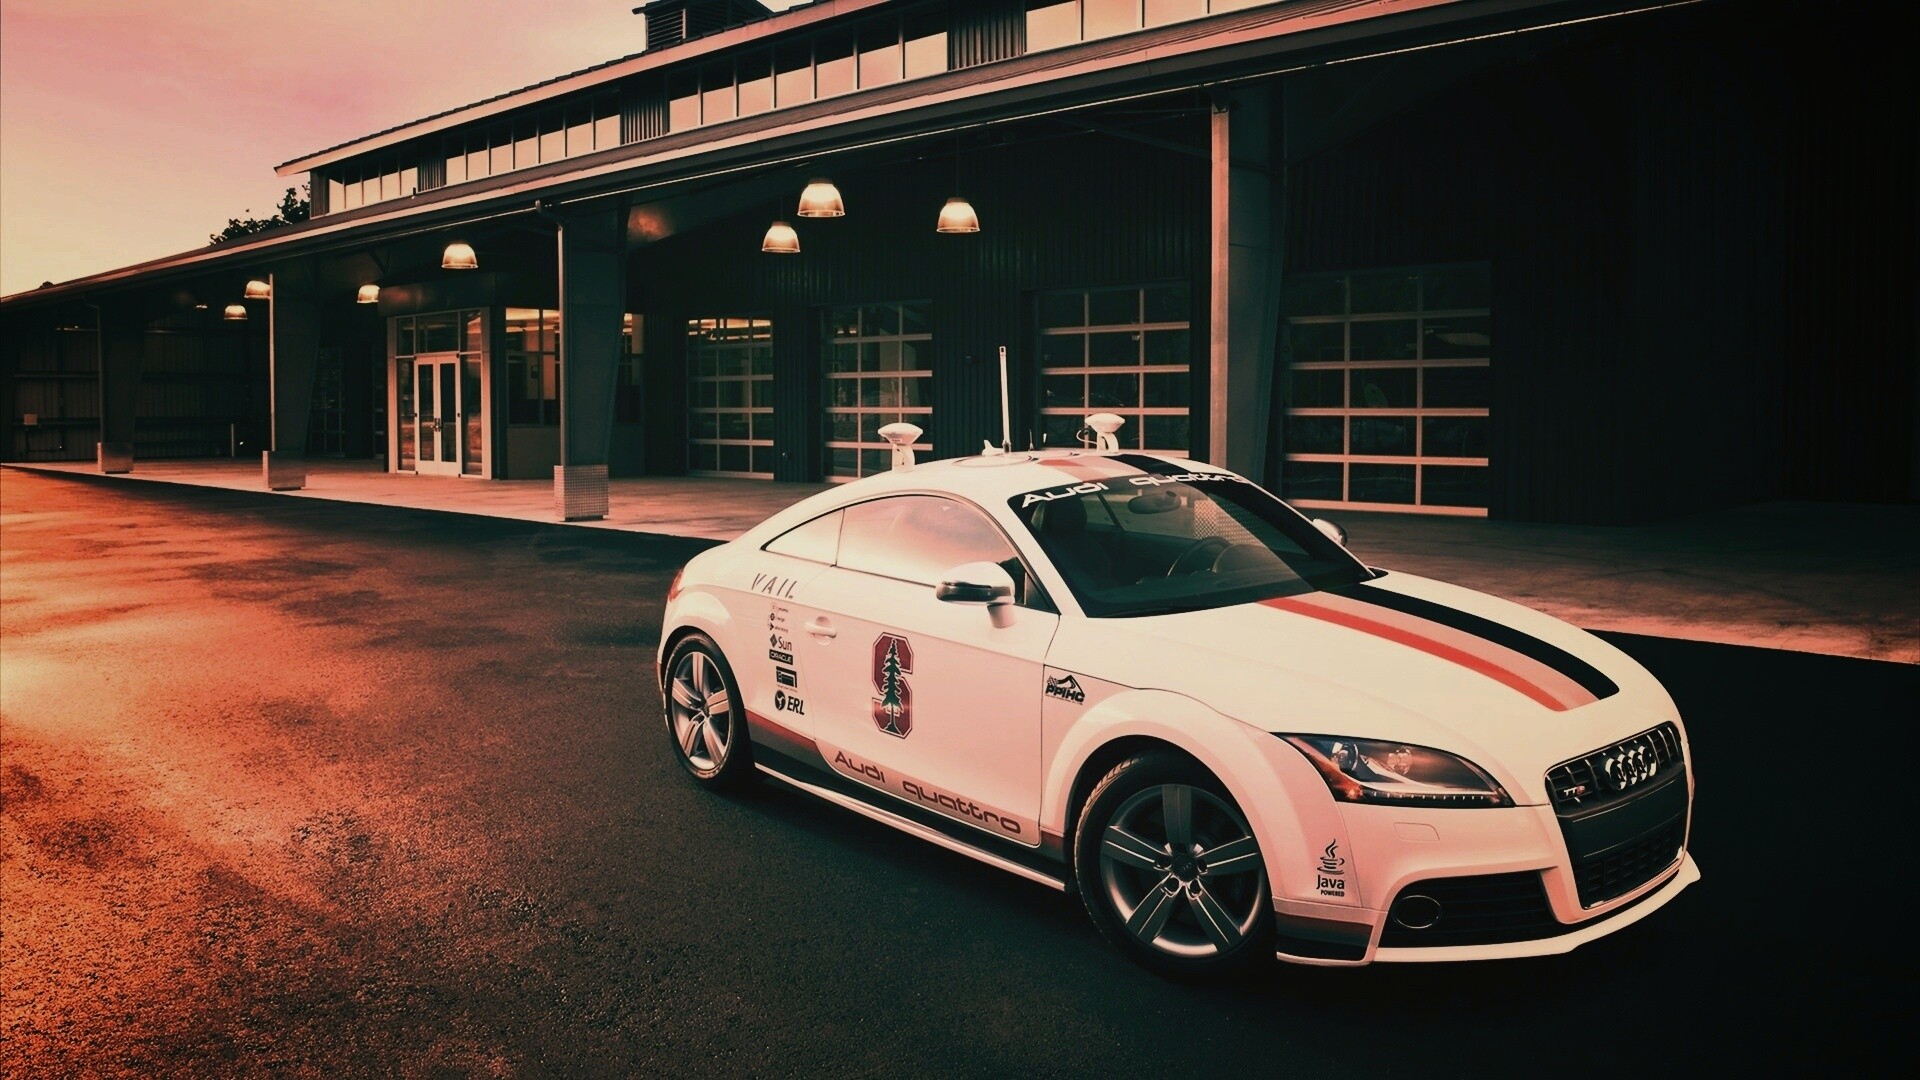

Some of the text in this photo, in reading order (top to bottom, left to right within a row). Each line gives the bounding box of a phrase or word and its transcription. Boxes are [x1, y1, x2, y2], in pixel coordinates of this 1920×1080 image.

[1021, 482, 1109, 508] Audi
[778, 636, 792, 651] Sun
[787, 695, 805, 716] ERL
[834, 750, 1022, 834] Audi quattro
[1316, 874, 1345, 890] Java
[1320, 889, 1346, 897] POWERED
